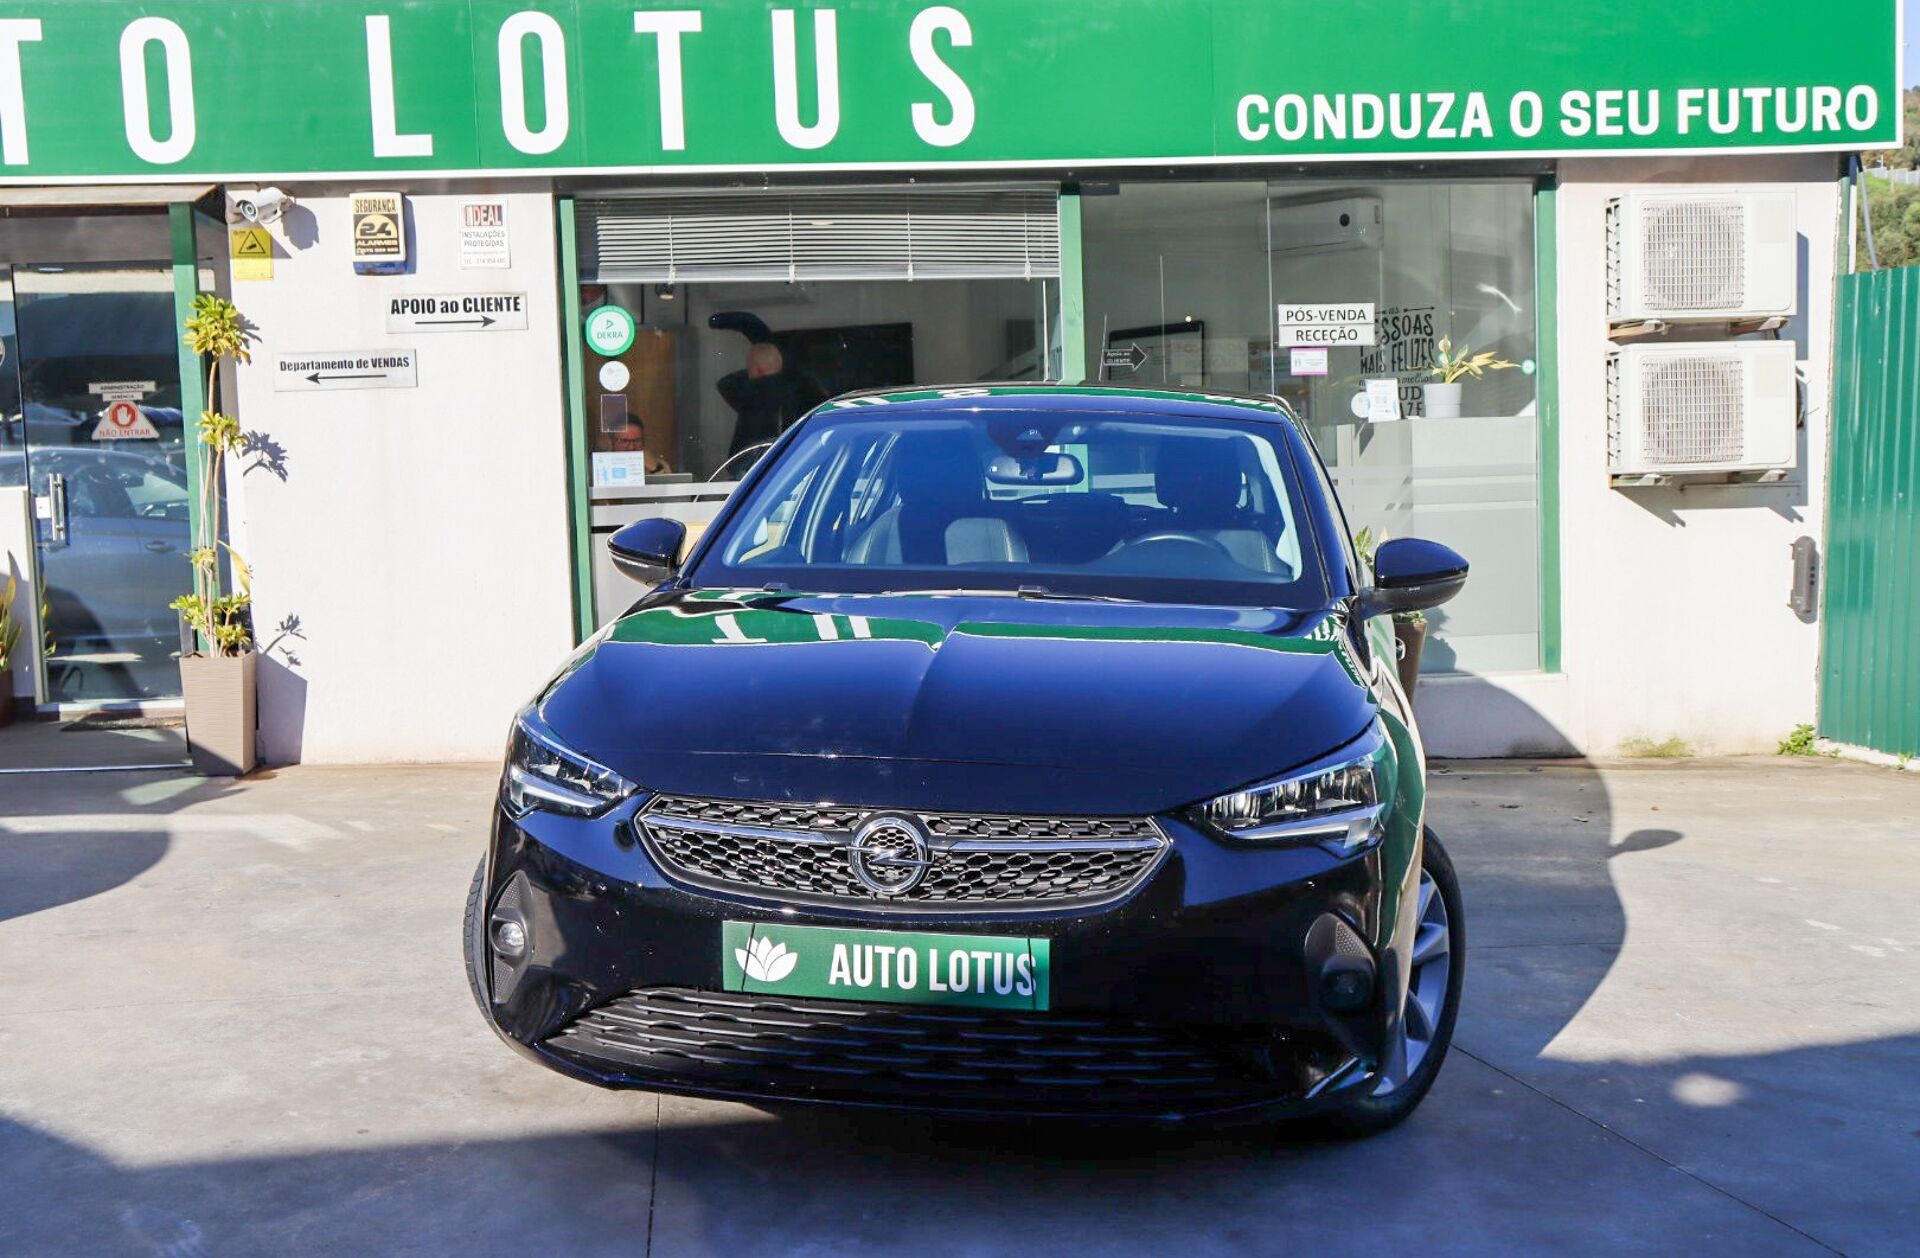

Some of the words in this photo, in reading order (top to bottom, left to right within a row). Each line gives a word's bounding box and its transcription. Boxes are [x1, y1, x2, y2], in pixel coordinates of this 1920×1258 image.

[364, 6, 976, 158] LOTUS
[1236, 91, 1494, 142] CONDUZA
[1509, 90, 1543, 138] O
[1559, 88, 1660, 137] SEU
[1677, 84, 1879, 135] FUTURO
[466, 206, 503, 226] IDEAL
[360, 222, 391, 236] 24
[464, 240, 505, 248] PROTEGIDAS
[391, 298, 436, 315] APOIO
[440, 299, 459, 314] ao
[463, 296, 521, 313] CLIENTE
[1286, 307, 1366, 322] PÓS-VENDA
[597, 331, 624, 340] DEKRA
[1296, 326, 1358, 343] RECEÇÃO
[1360, 314, 1434, 356] SSOAS
[280, 358, 354, 372] Departamento
[356, 358, 369, 369] de
[371, 356, 410, 369] VENDAS
[1360, 350, 1387, 375] MAIS
[99, 428, 117, 438] NÃO
[119, 428, 151, 437] ENTRAR
[829, 943, 917, 991] AUTO
[929, 948, 1037, 996] LOTUS
